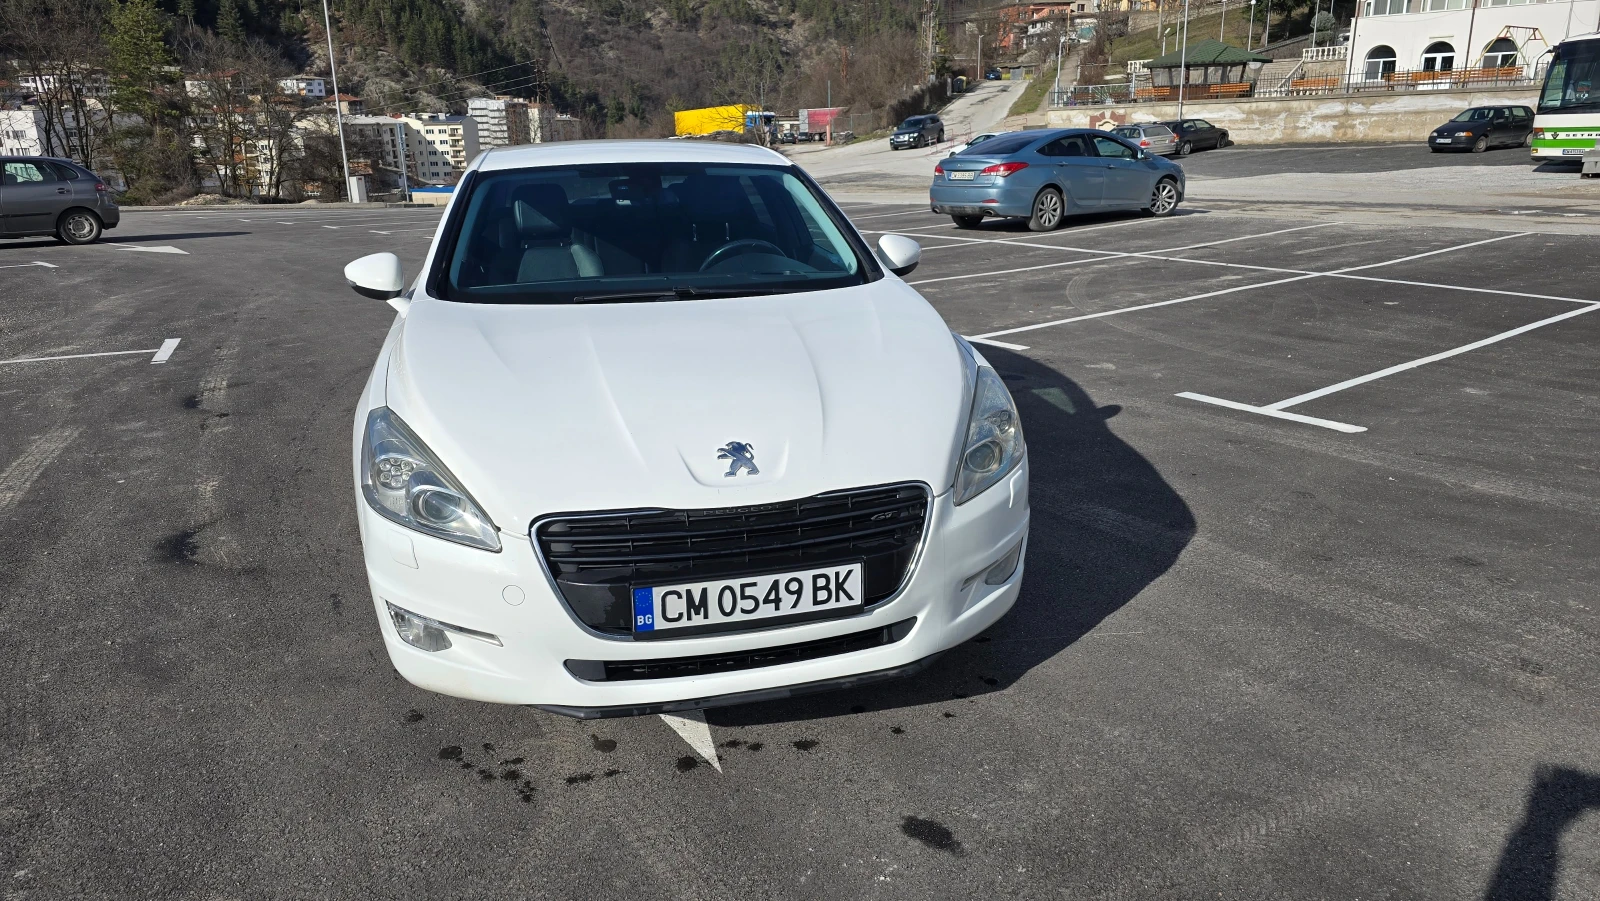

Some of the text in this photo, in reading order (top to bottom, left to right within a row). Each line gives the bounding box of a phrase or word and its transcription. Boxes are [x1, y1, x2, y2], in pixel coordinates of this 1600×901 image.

[703, 503, 782, 515] PEUGEOT
[660, 569, 855, 623] CM 0549 BK
[637, 614, 653, 626] BG
